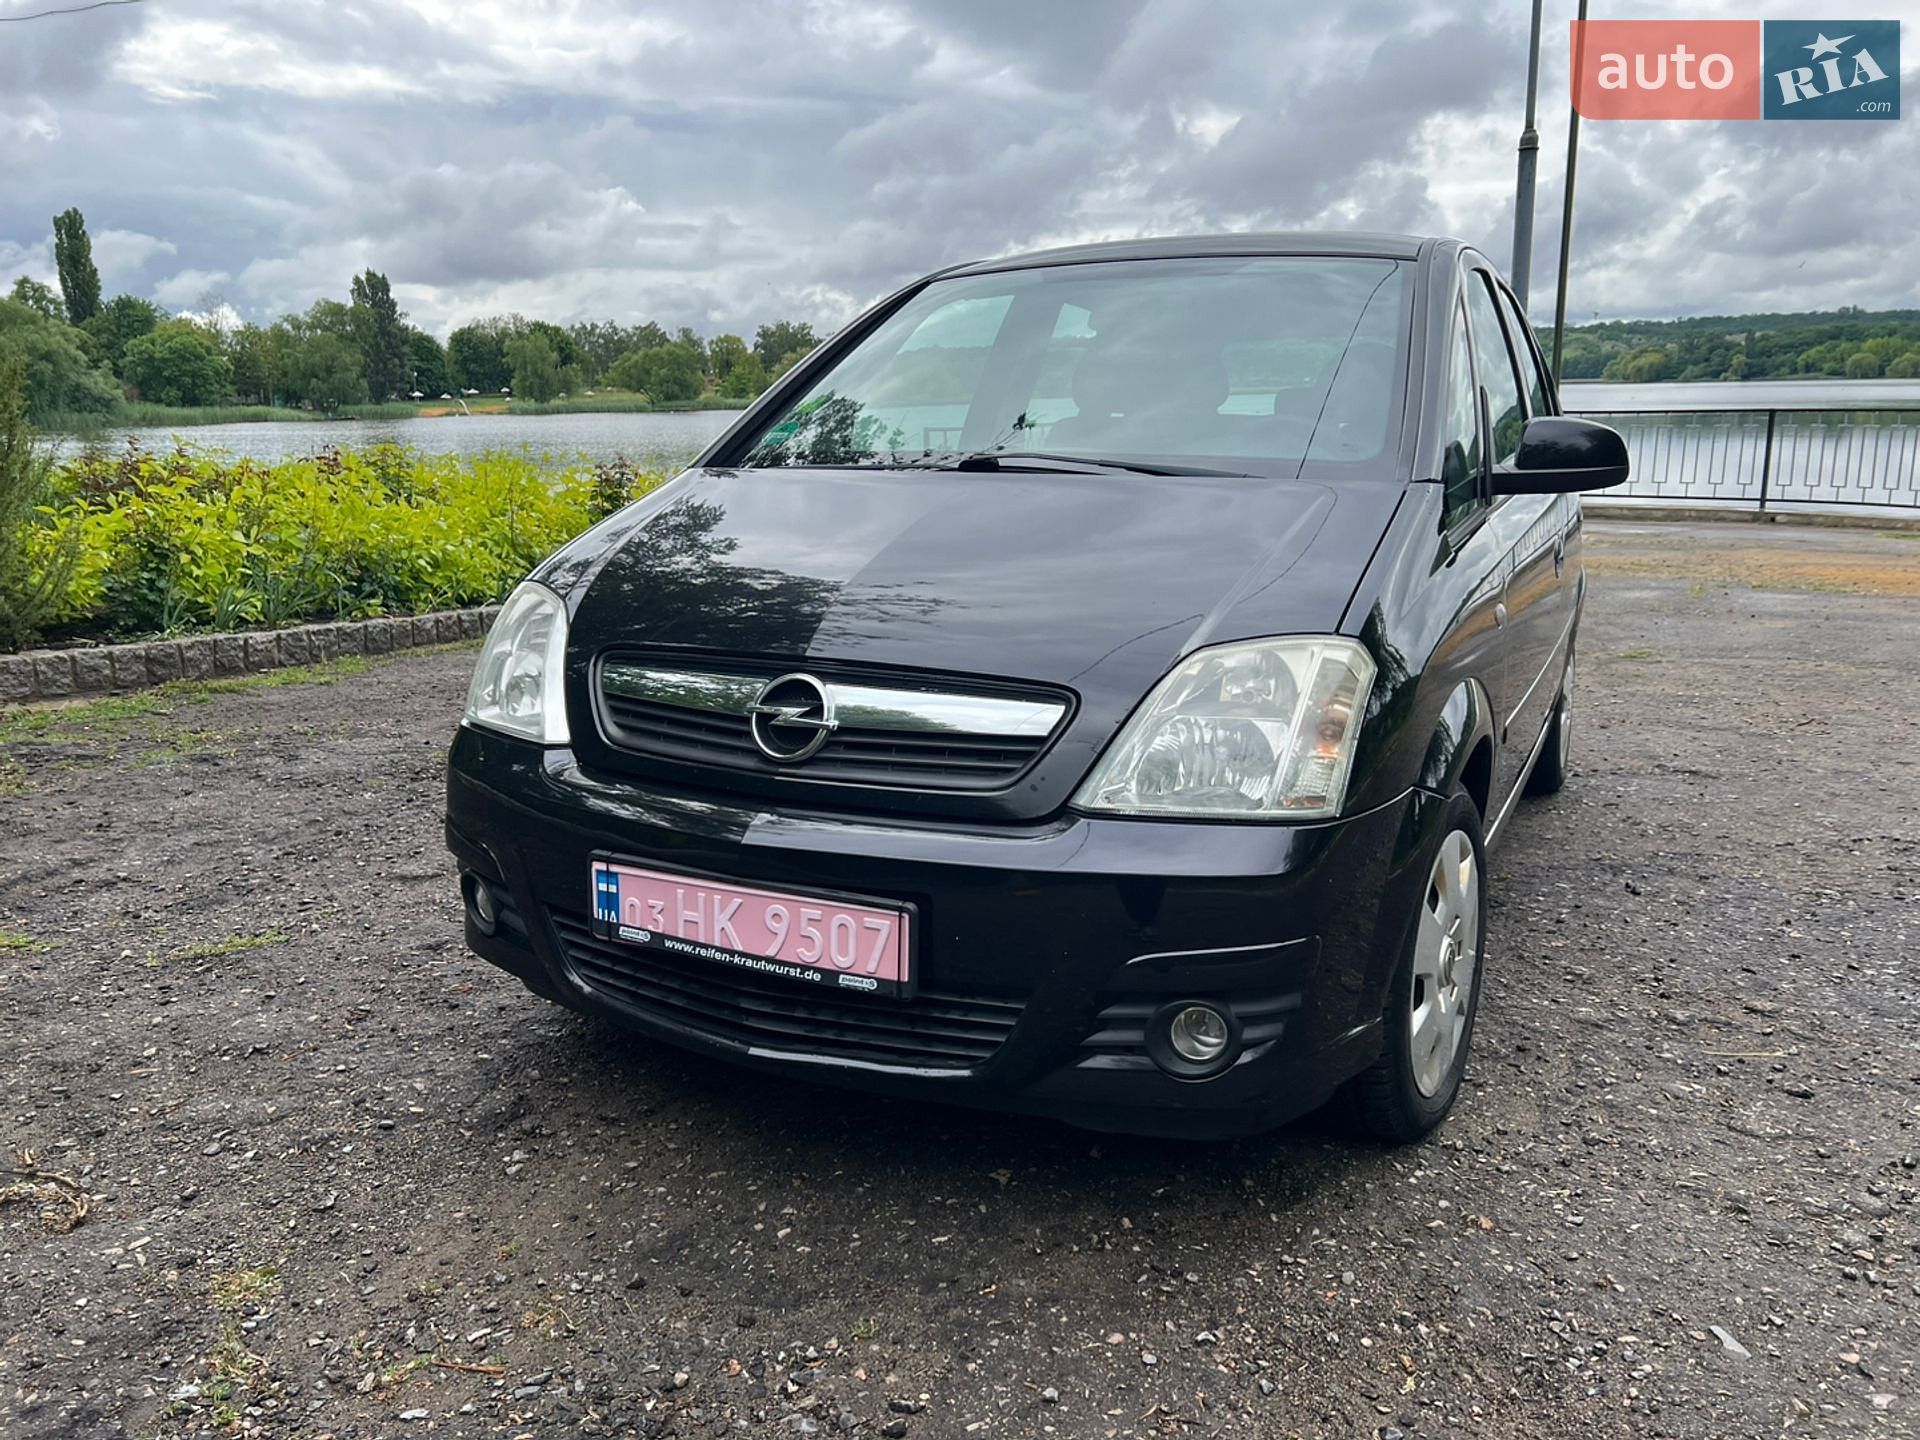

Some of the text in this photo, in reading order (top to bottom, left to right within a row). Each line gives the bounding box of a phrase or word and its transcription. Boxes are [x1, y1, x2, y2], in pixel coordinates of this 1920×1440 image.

[624, 889, 891, 974] 03 HK 9507
[664, 938, 822, 981] www.reifen-krautwurst.de
